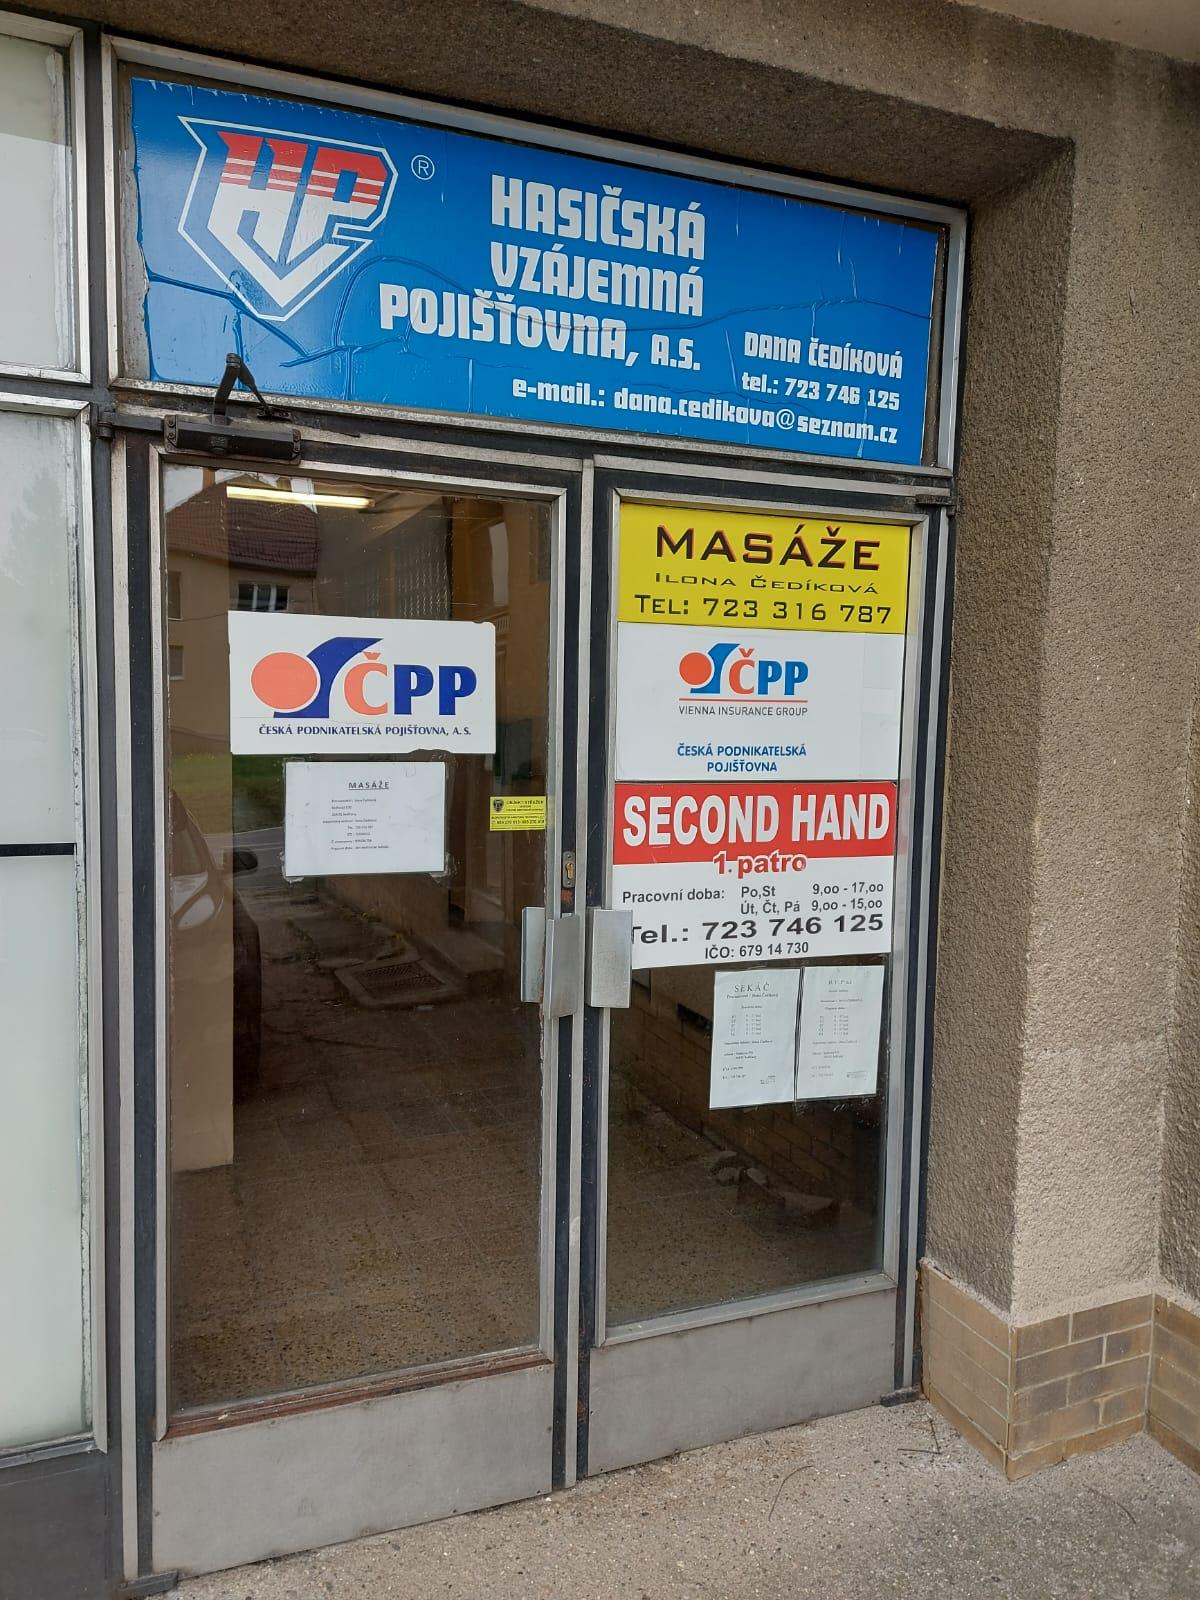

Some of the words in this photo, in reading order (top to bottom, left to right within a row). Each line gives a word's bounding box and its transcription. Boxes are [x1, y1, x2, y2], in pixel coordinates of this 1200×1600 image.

[491, 174, 706, 260] HASIČSKÁ
[490, 241, 704, 317] VZÁJEMNÁ
[379, 282, 640, 367] POJIŠŤOVNA,
[744, 331, 801, 364] DANA
[808, 336, 903, 379] ČEDÍKOVÁ
[742, 371, 779, 396] tel.:
[784, 376, 820, 401] 723
[826, 381, 861, 406] 746
[868, 386, 900, 411] 125
[512, 377, 606, 407] e-mail.:
[613, 388, 898, 444] dana.cedikova@seznam.cz
[656, 523, 881, 571] MASÁŽE
[655, 572, 737, 587] ILONA
[750, 575, 879, 594] ČEDÍKOVÁ
[703, 598, 758, 618] 723
[772, 601, 826, 621] 316
[840, 604, 892, 624] 787
[343, 651, 477, 716] ČPP
[728, 647, 809, 696] ČPP
[678, 705, 715, 716] VIENNA
[718, 706, 773, 716] INSURANCE
[775, 706, 808, 717] GROUP
[259, 723, 293, 735] ČESKÁ
[297, 723, 382, 736] PODNIKATELSKÁ
[385, 724, 449, 736] POJIŠŤOVNA,
[677, 742, 713, 757] ČESKÁ
[717, 743, 807, 757] PODNIKATELSKÁ
[706, 758, 778, 773] POJIŠŤOVNA
[622, 795, 780, 847] SECOND
[791, 793, 890, 842] HAND
[713, 850, 733, 876] 1.
[737, 849, 807, 879] patro
[622, 888, 683, 904] Pracovní
[687, 888, 725, 901] doba:
[741, 885, 776, 899] Po,St
[740, 901, 758, 915] Út,
[762, 900, 780, 915] Čt,
[784, 901, 801, 913] Pá
[702, 920, 758, 941] 723
[768, 917, 822, 937] 746
[833, 913, 884, 933] 125
[705, 945, 735, 960] IČO:
[739, 944, 763, 958] 679
[767, 943, 783, 956] 14
[786, 942, 809, 955] 730
